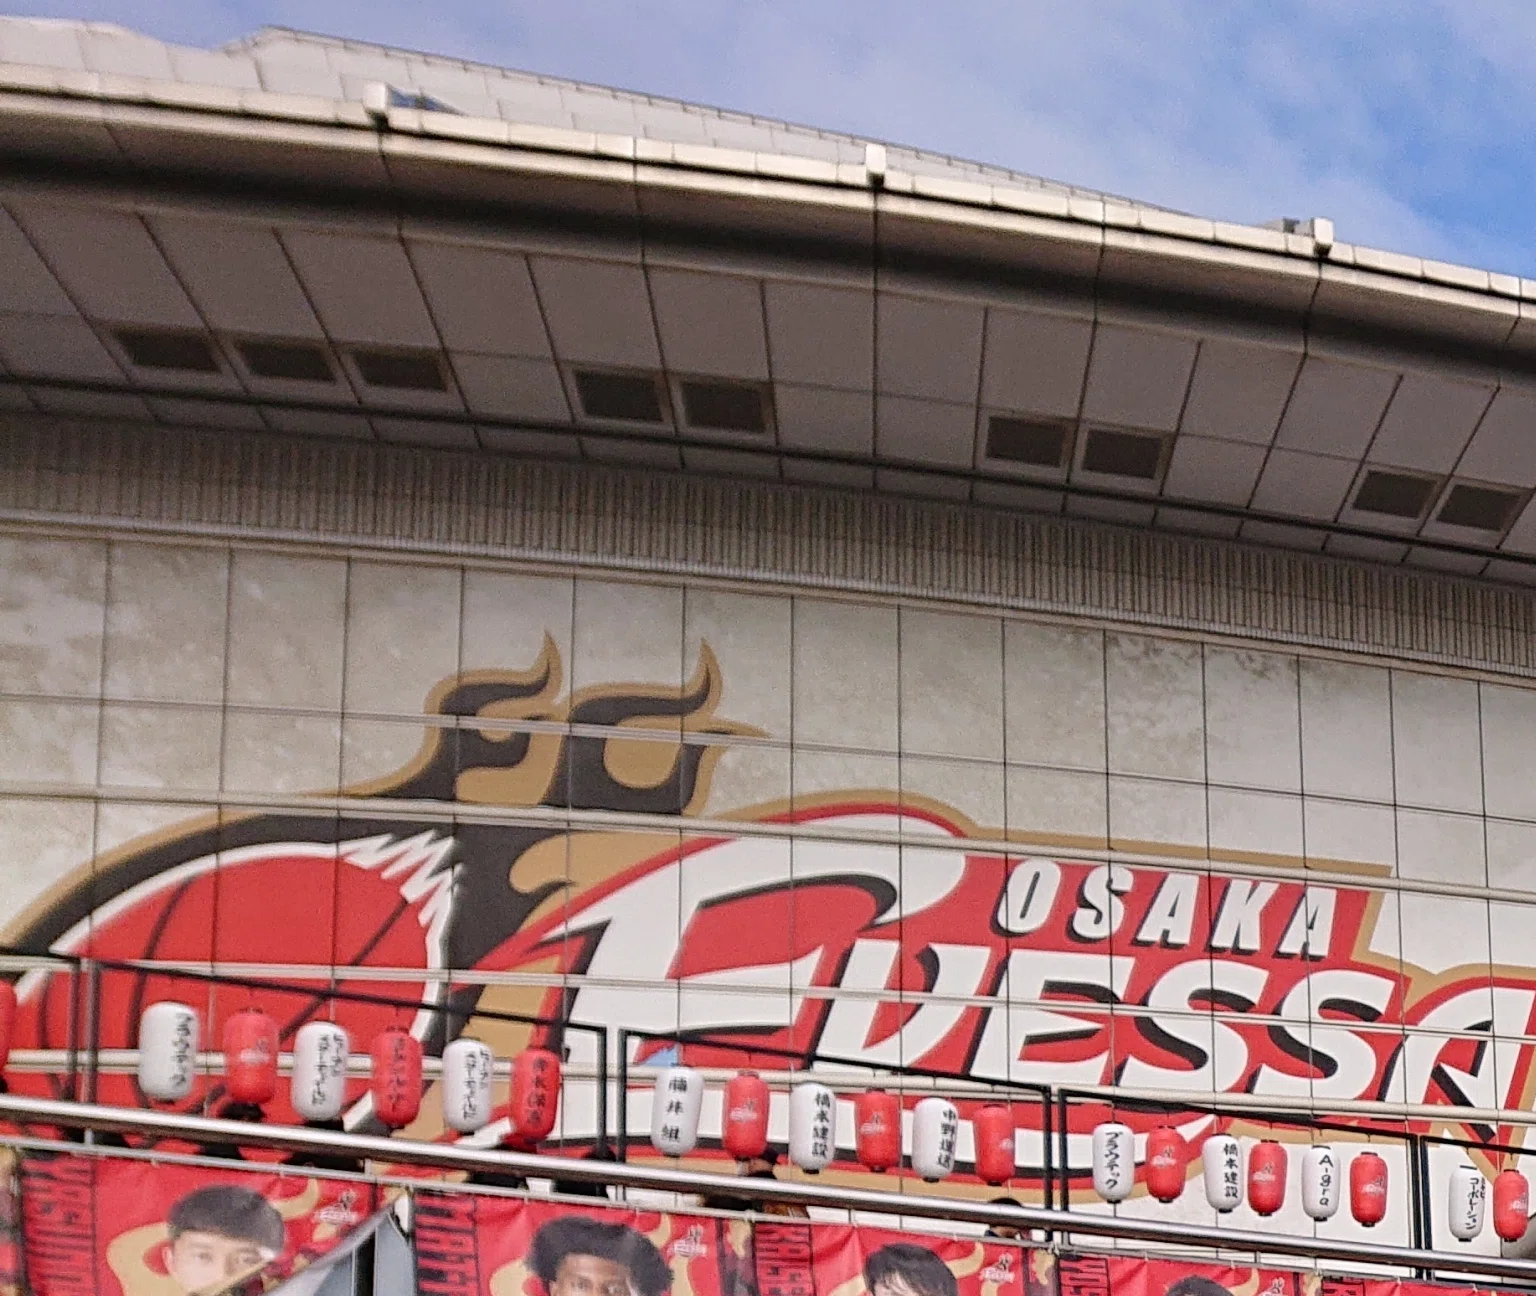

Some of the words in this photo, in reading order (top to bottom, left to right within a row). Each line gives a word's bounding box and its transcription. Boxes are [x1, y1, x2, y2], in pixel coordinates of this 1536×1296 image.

[994, 857, 1332, 962] OSAKA
[811, 1091, 831, 1161] 橋本建設
[1104, 1131, 1124, 1191] ブラウテック
[1223, 1142, 1240, 1200] 橋本建設
[1465, 1176, 1480, 1231] コーポレーション
